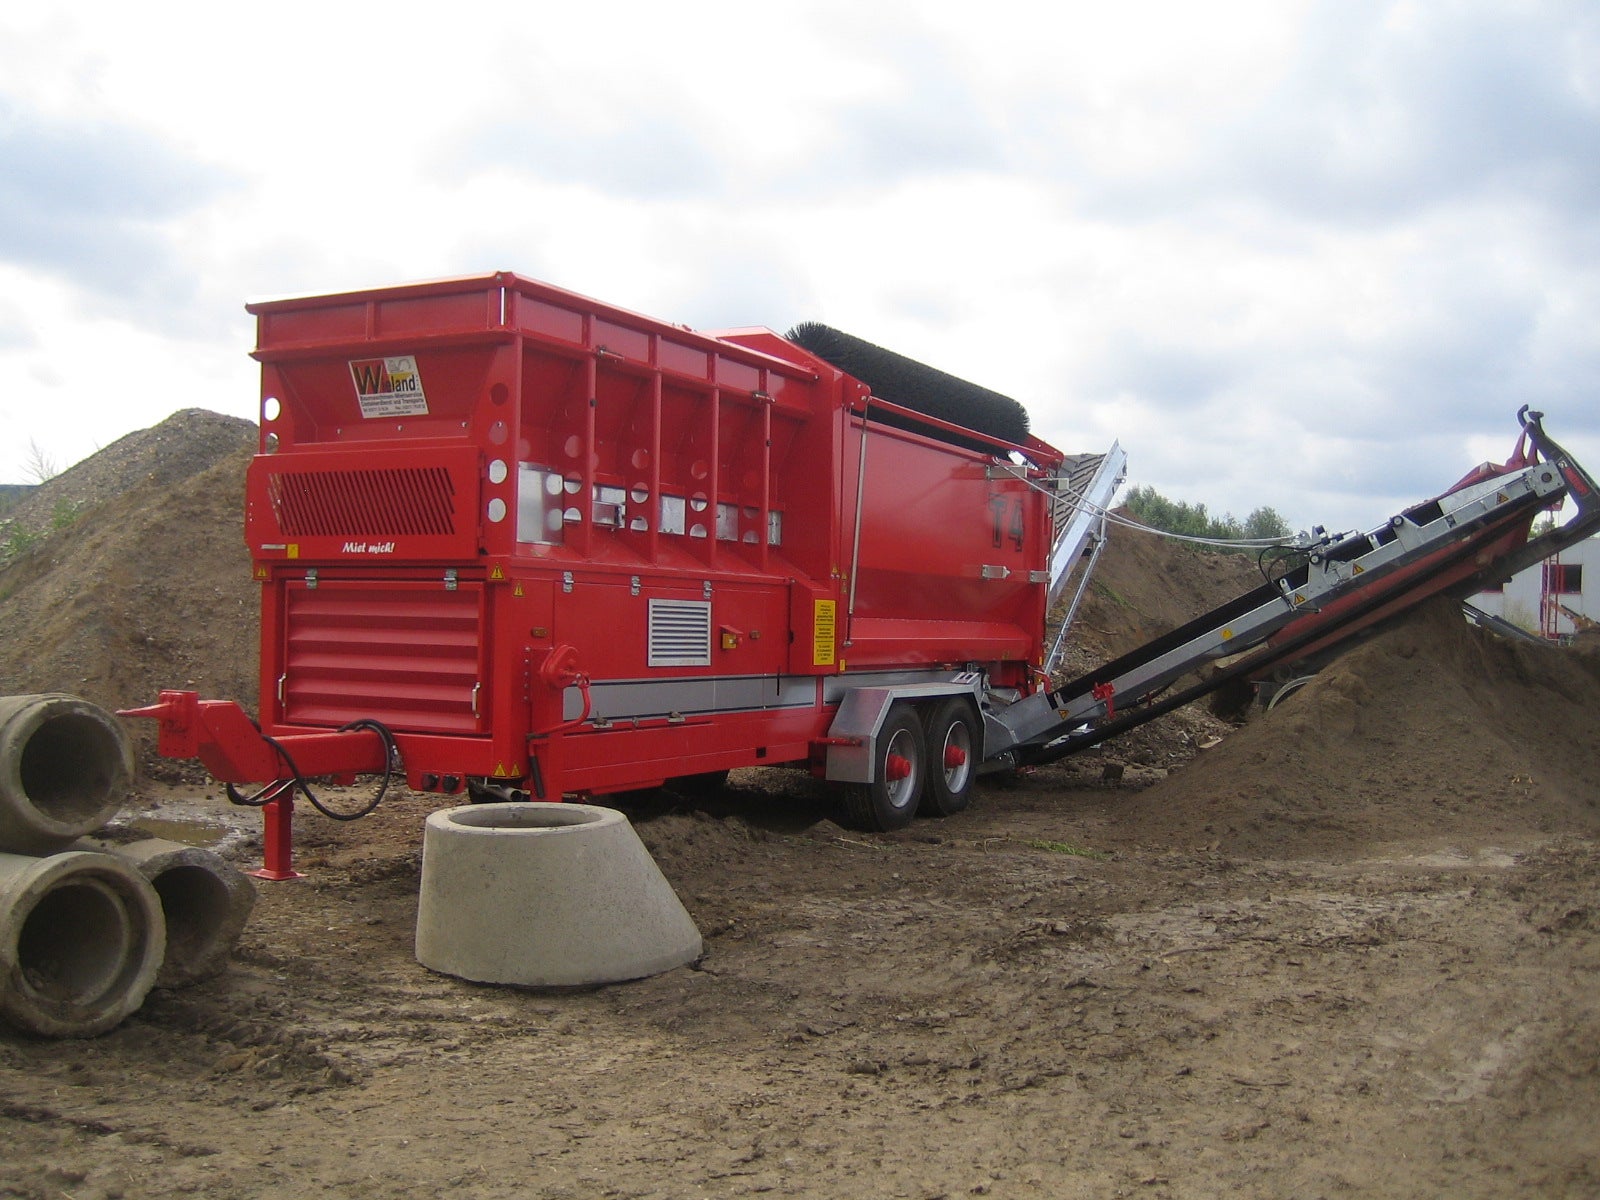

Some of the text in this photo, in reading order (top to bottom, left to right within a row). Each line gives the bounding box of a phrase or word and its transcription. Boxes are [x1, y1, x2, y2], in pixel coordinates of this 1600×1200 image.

[988, 492, 1024, 552] T4
[342, 542, 395, 554] Miet mich!
